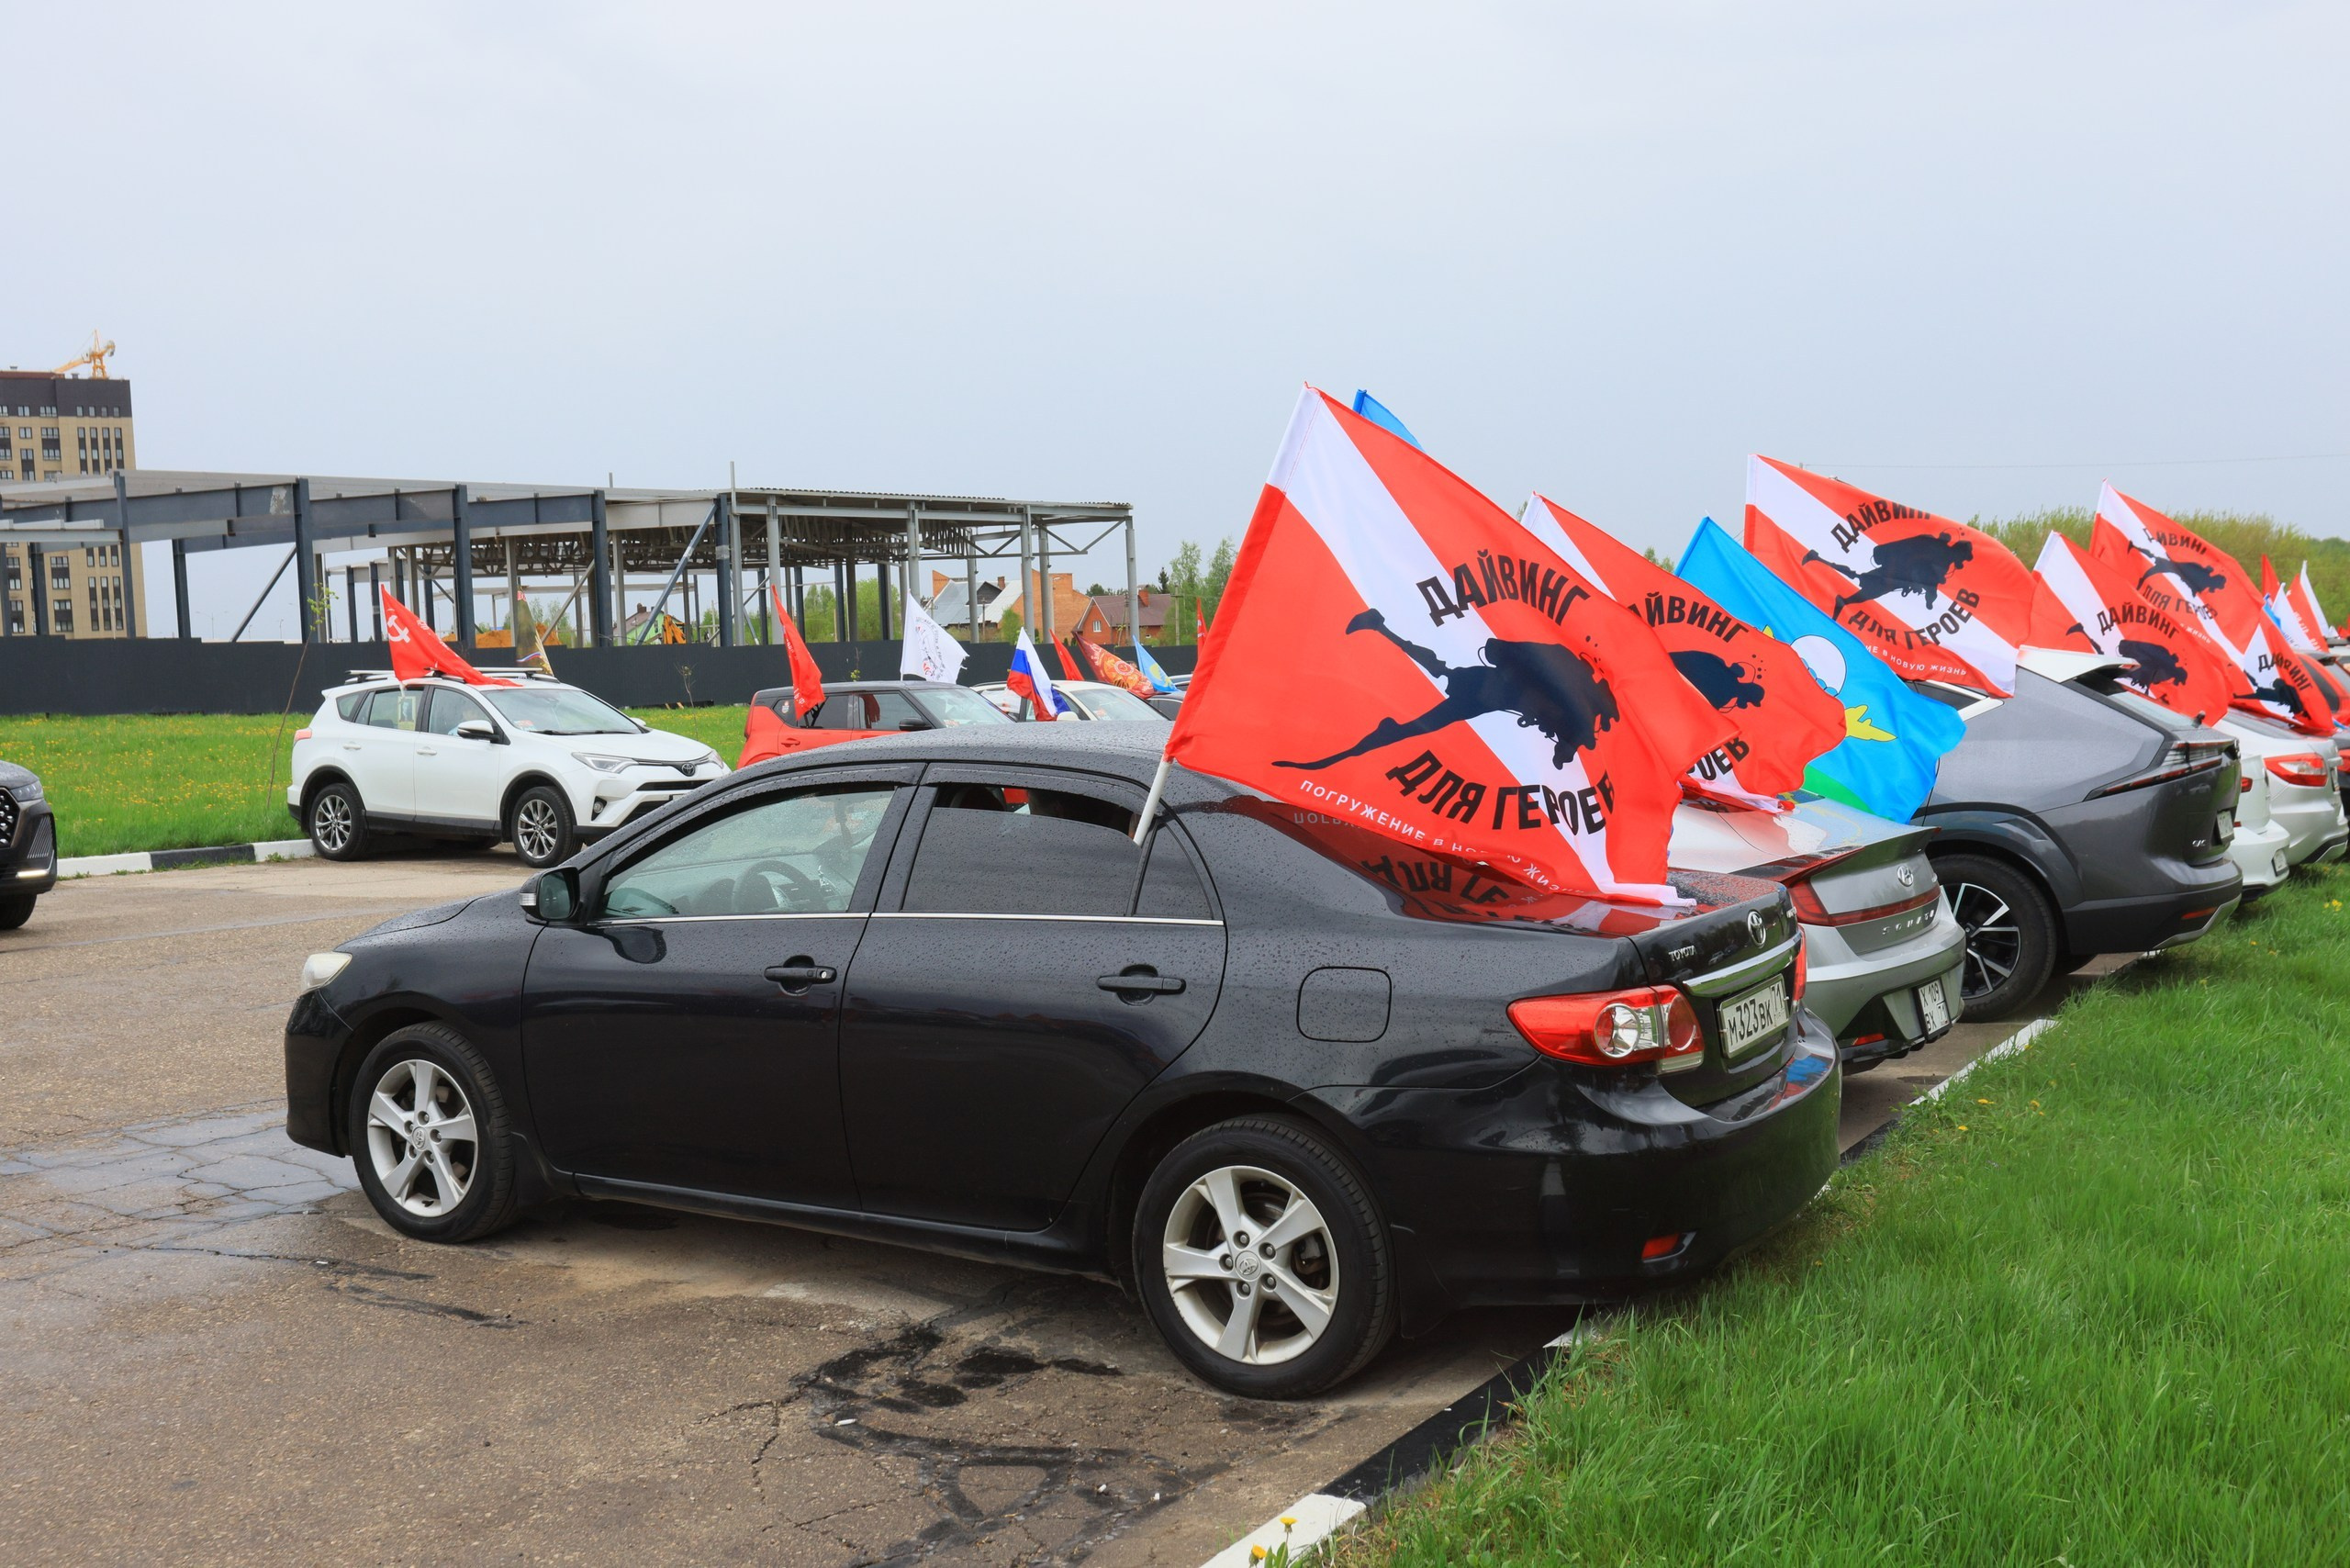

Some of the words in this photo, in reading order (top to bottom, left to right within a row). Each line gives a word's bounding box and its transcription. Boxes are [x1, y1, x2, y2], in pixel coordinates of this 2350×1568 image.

[1416, 549, 1591, 627] ДАЙВИНГ
[1847, 610, 1897, 645] ДЛЯ
[1904, 588, 1980, 650] ГЕРОЕВ
[2097, 602, 2180, 639] ДАЙВИНГ
[1890, 655, 1925, 672] НОВУЮ
[1930, 664, 1967, 677] ЖИЗНЬ
[1300, 780, 1426, 841] ПОГРУЖЕНИЕ
[1385, 750, 1487, 824] ДЛЯ
[1492, 770, 1615, 835] ГЕРОЕВ
[1668, 945, 1697, 961] TOYOTA
[1771, 983, 1784, 1013] 71
